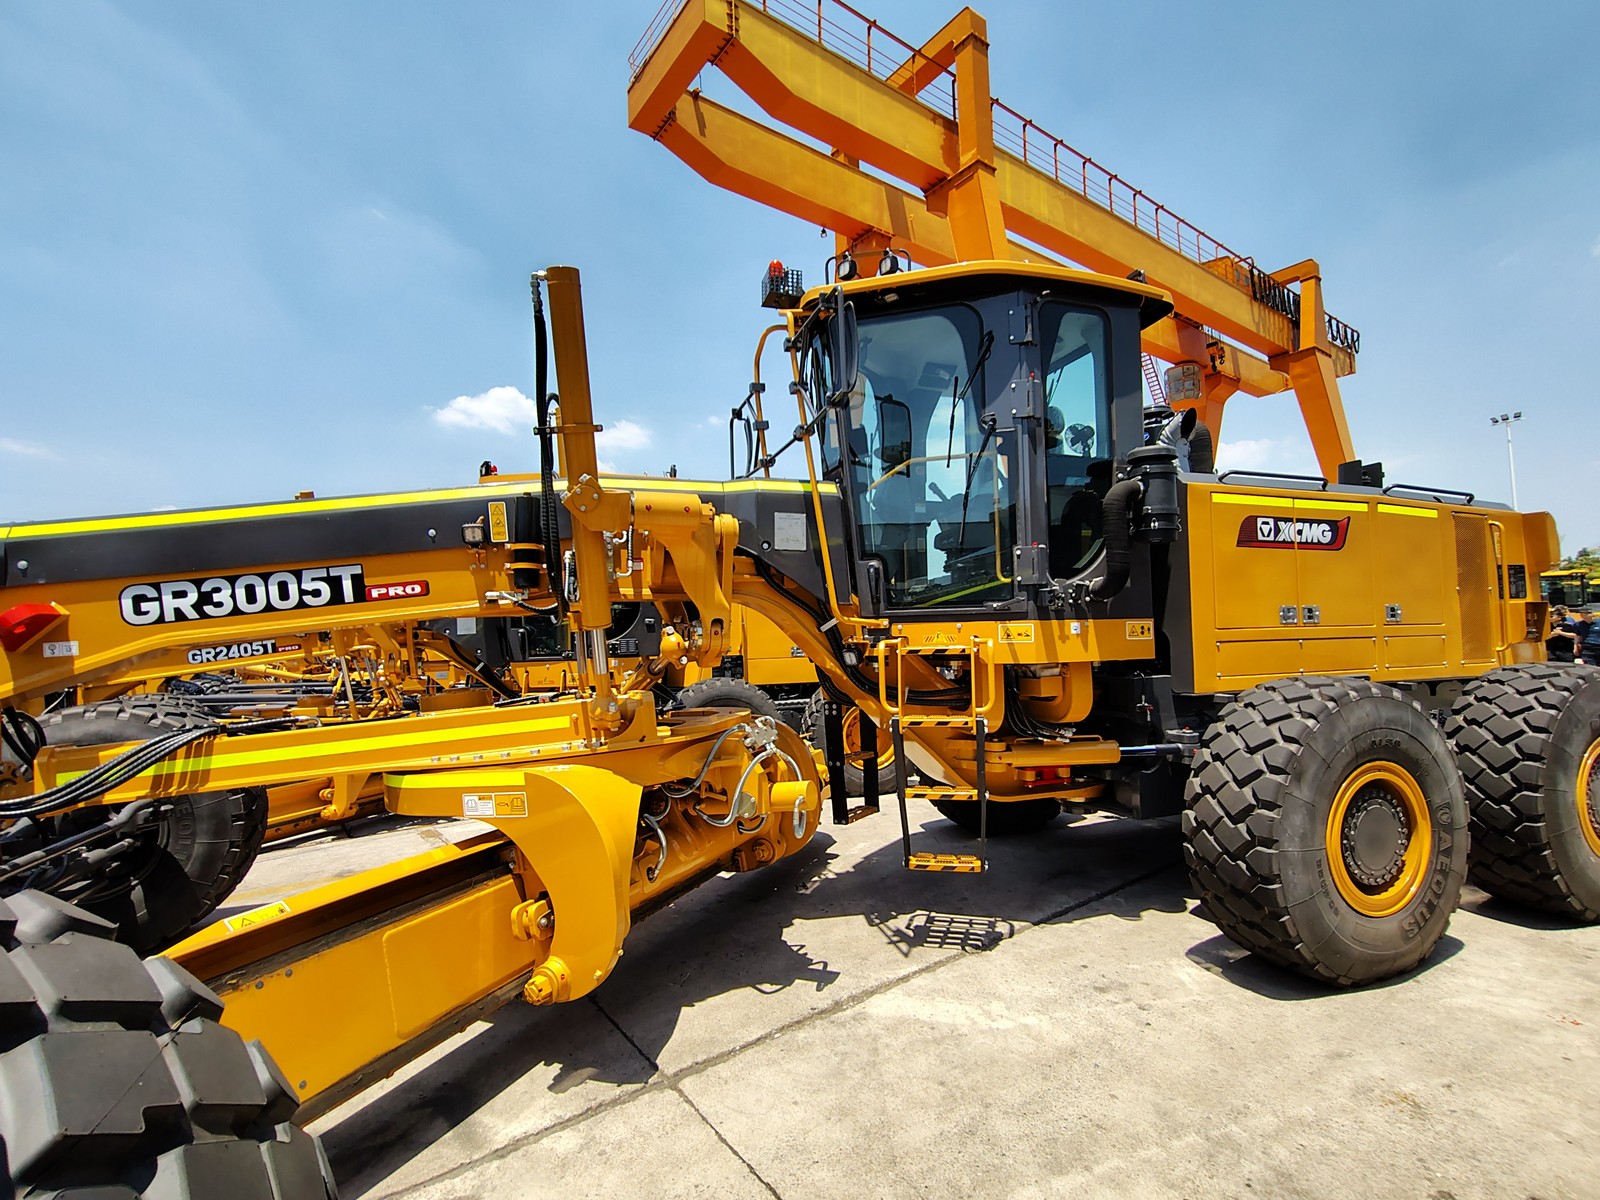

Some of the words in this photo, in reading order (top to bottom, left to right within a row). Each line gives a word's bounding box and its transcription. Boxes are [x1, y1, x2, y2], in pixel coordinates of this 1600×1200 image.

[1275, 521, 1332, 544] XCMG
[121, 564, 362, 625] GR3005T
[370, 584, 422, 598] PRO
[187, 639, 275, 665] GR2405T
[1402, 830, 1452, 938] AEOLUS
